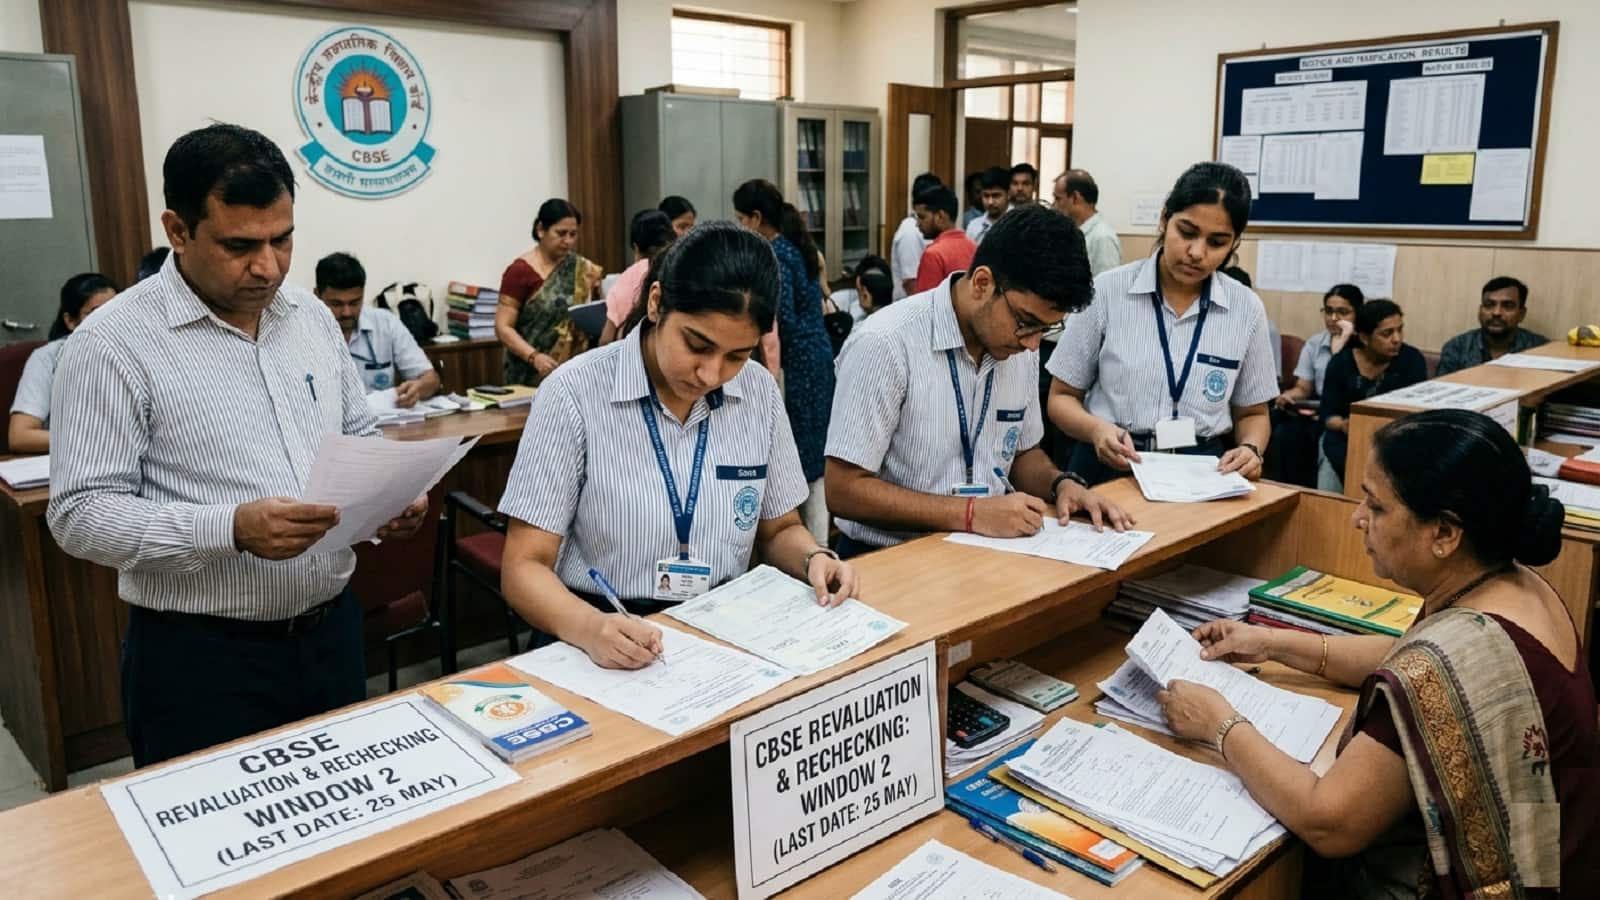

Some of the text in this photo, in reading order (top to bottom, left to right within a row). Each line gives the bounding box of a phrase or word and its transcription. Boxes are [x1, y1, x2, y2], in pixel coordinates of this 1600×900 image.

[352, 149, 391, 164] CBSE
[238, 732, 341, 774] CBSE
[755, 674, 922, 769] CBSE REVALUATION
[776, 714, 910, 794] & RECHECKING:
[155, 727, 440, 828] REVALUATION & RECHECKING
[244, 767, 401, 828] WINDOW 2
[800, 754, 892, 816] WINDOW 2
[217, 773, 458, 866] (LAST DATE: 25 MAY)
[773, 773, 918, 864] (LAST DATE: 25 MAY)
